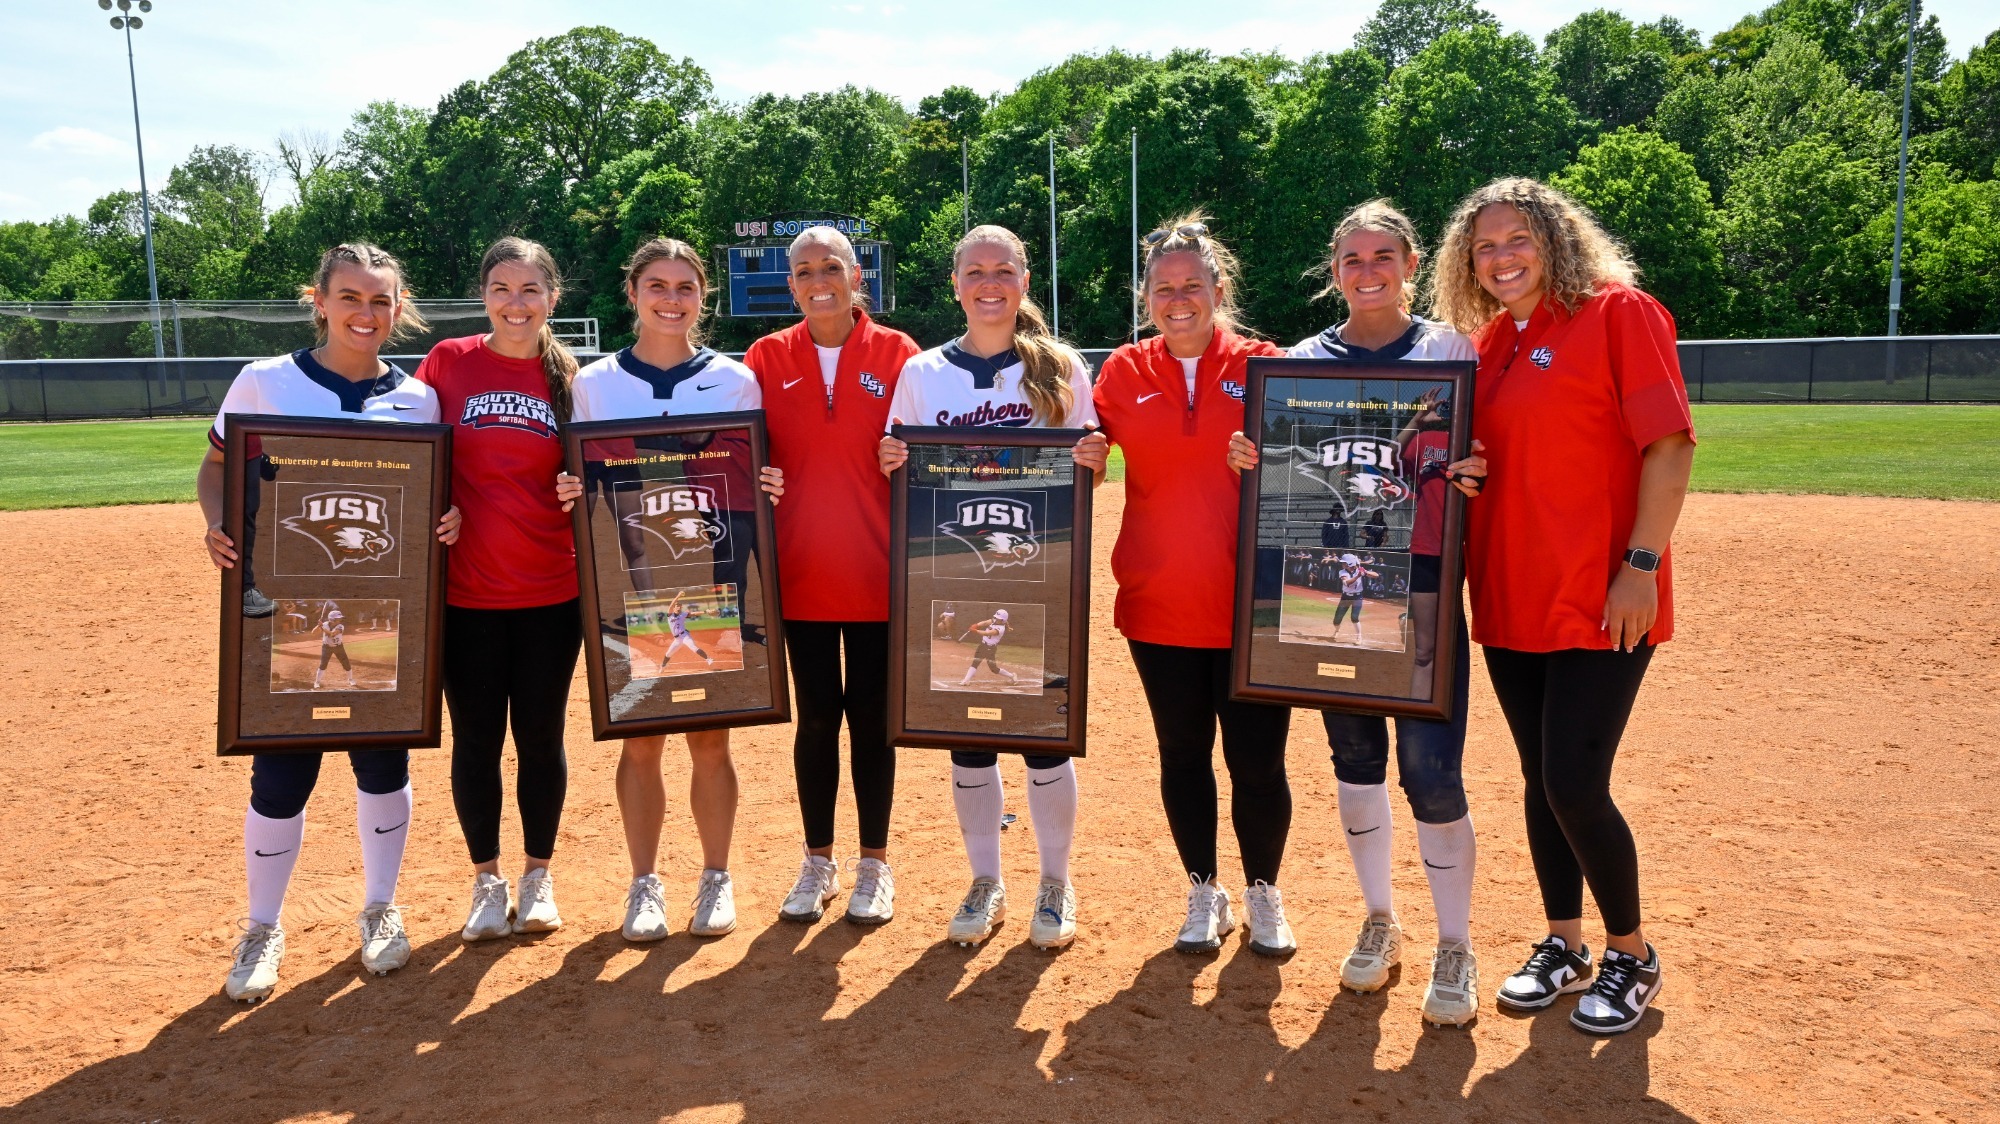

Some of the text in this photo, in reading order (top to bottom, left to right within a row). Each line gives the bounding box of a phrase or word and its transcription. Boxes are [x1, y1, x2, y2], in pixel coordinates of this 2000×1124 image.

[735, 222, 767, 236] USI
[740, 248, 765, 258] INNING
[860, 246, 873, 255] OUT
[860, 372, 885, 397] USI
[1221, 381, 1245, 402] US
[467, 393, 556, 419] SOUTHERN
[936, 400, 1033, 426] Southern
[1286, 398, 1428, 411] University of Southern Indiana
[463, 403, 558, 431] INDIANA
[498, 416, 528, 426] SOFTBALL
[269, 456, 319, 467] University
[331, 458, 373, 468] Southern
[375, 460, 411, 469] Indiana
[604, 450, 731, 467] University of Southern Indiana
[1323, 442, 1394, 469] USI
[928, 464, 1054, 475] University of Southern Indiana
[309, 498, 380, 524] USI
[645, 490, 712, 516] USI
[962, 503, 1026, 530] USI
